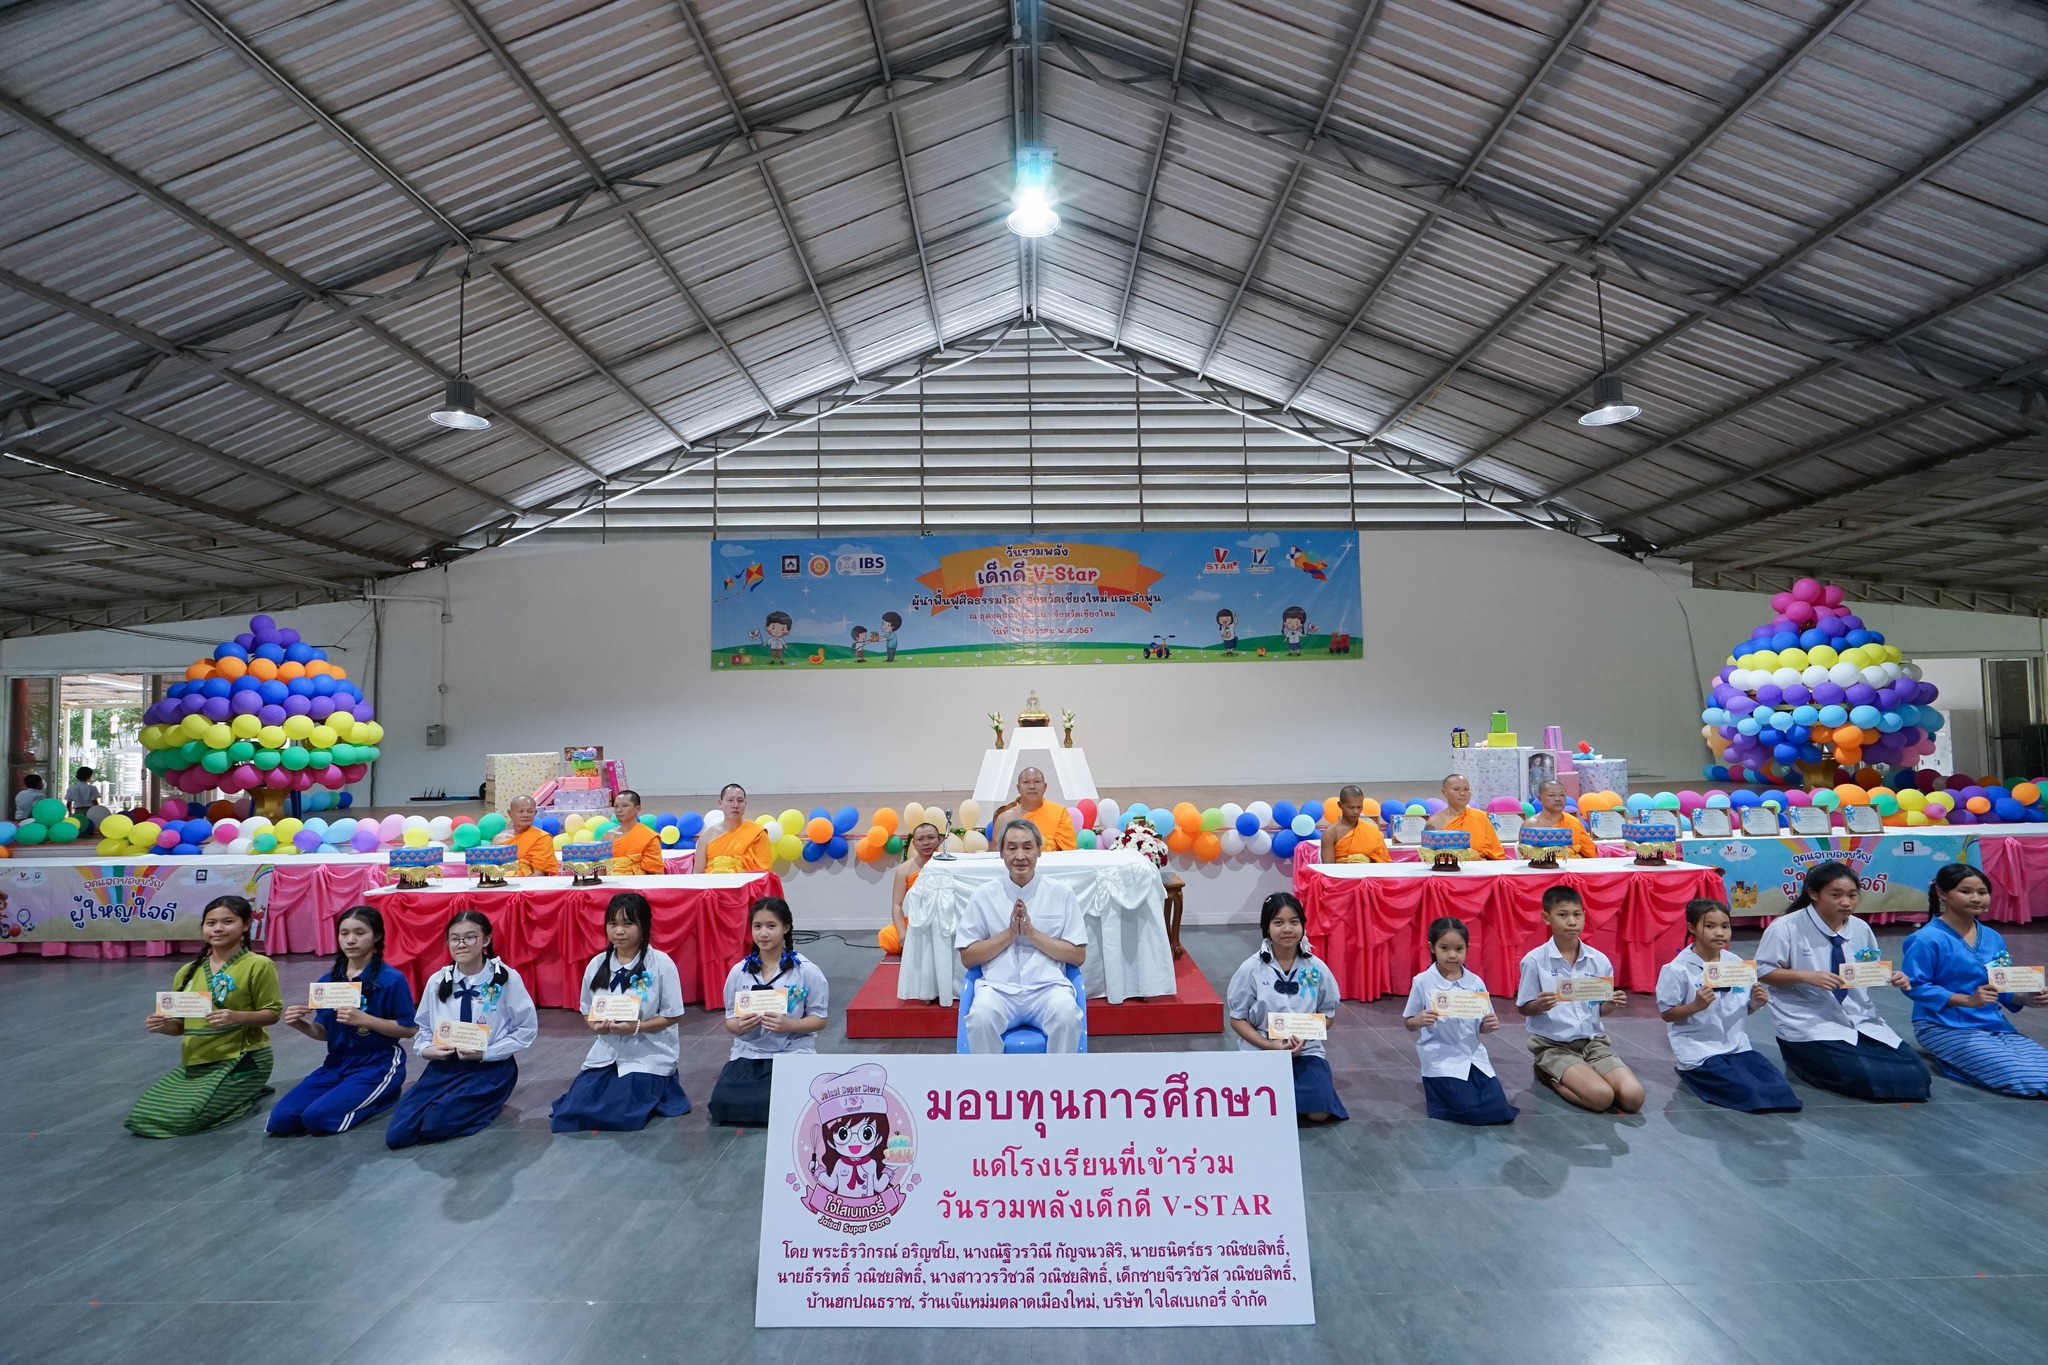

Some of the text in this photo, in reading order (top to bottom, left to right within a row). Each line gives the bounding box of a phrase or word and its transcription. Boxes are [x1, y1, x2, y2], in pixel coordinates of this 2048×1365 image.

[1006, 544, 1069, 558] วันรวมพลัง
[1214, 548, 1229, 563] V
[859, 557, 884, 569] IBS
[978, 561, 1098, 584] เด็กดี V-Star
[912, 589, 1162, 610] ผู้นำฟื้นฟูศีลธรรมโลก จังหวัดเชียงใหม่ และลำพูน
[1792, 848, 1872, 866] จุดแจกของขวัญ
[83, 875, 165, 891] จุดแจกของขวัญ
[70, 891, 177, 929] ผู้ใหญ่ใจดี
[926, 1071, 1277, 1139] มอบทุนการศึกษา
[972, 1141, 1234, 1177] แด่โรงเรียนที่เข้าร่วม
[824, 1194, 886, 1218] ใจใสเบเกอรี่
[937, 1187, 1272, 1219] วันรวมพลังเด็กดี V-STAR
[818, 1215, 891, 1235] Jaisai Super Store
[782, 1240, 809, 1259] โดย
[1056, 1241, 1127, 1263] กัญจนวสิริ,
[1217, 1234, 1290, 1258] วณิชยสิทธิ์,
[854, 1262, 926, 1286] วณิชยสิทธิ์,
[1038, 1261, 1112, 1285] วณิชยสิทธิ์,
[1222, 1259, 1297, 1283] วณิชยสิทธิ์,
[918, 1288, 1100, 1309] ร้านเจ๊แหม่มตลาดเมืองใหม่,
[1103, 1291, 1144, 1309] บริษัท
[1144, 1287, 1227, 1308] ใจใสเบเกอรี่
[1231, 1289, 1267, 1307] จำกัด
